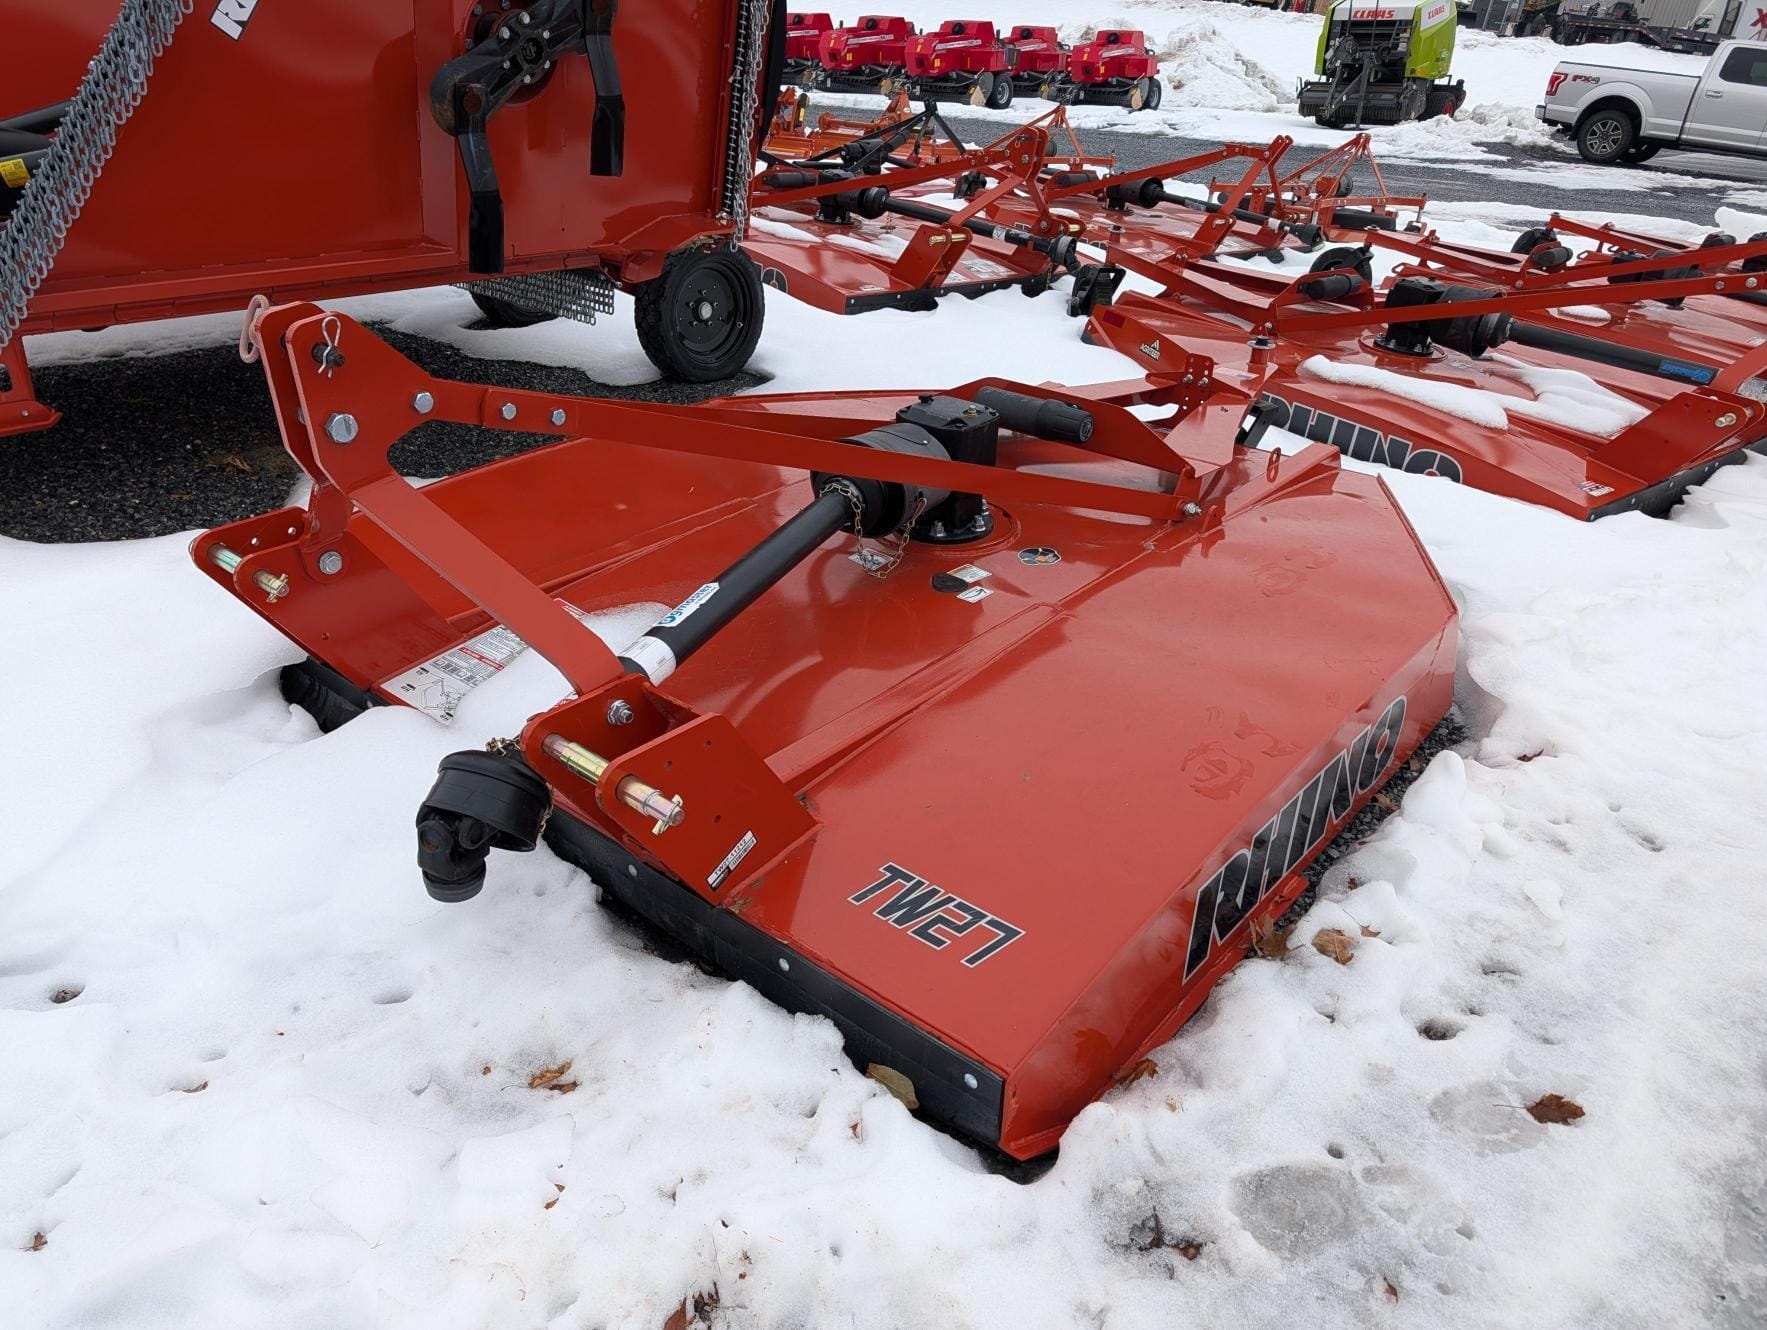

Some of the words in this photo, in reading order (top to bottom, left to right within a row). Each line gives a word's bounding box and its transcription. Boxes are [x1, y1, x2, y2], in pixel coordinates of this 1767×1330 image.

[1352, 9, 1396, 21] CLAAS
[1427, 4, 1446, 20] CLAAS
[1181, 694, 1408, 986] RHINO
[846, 861, 1026, 968] TW27
